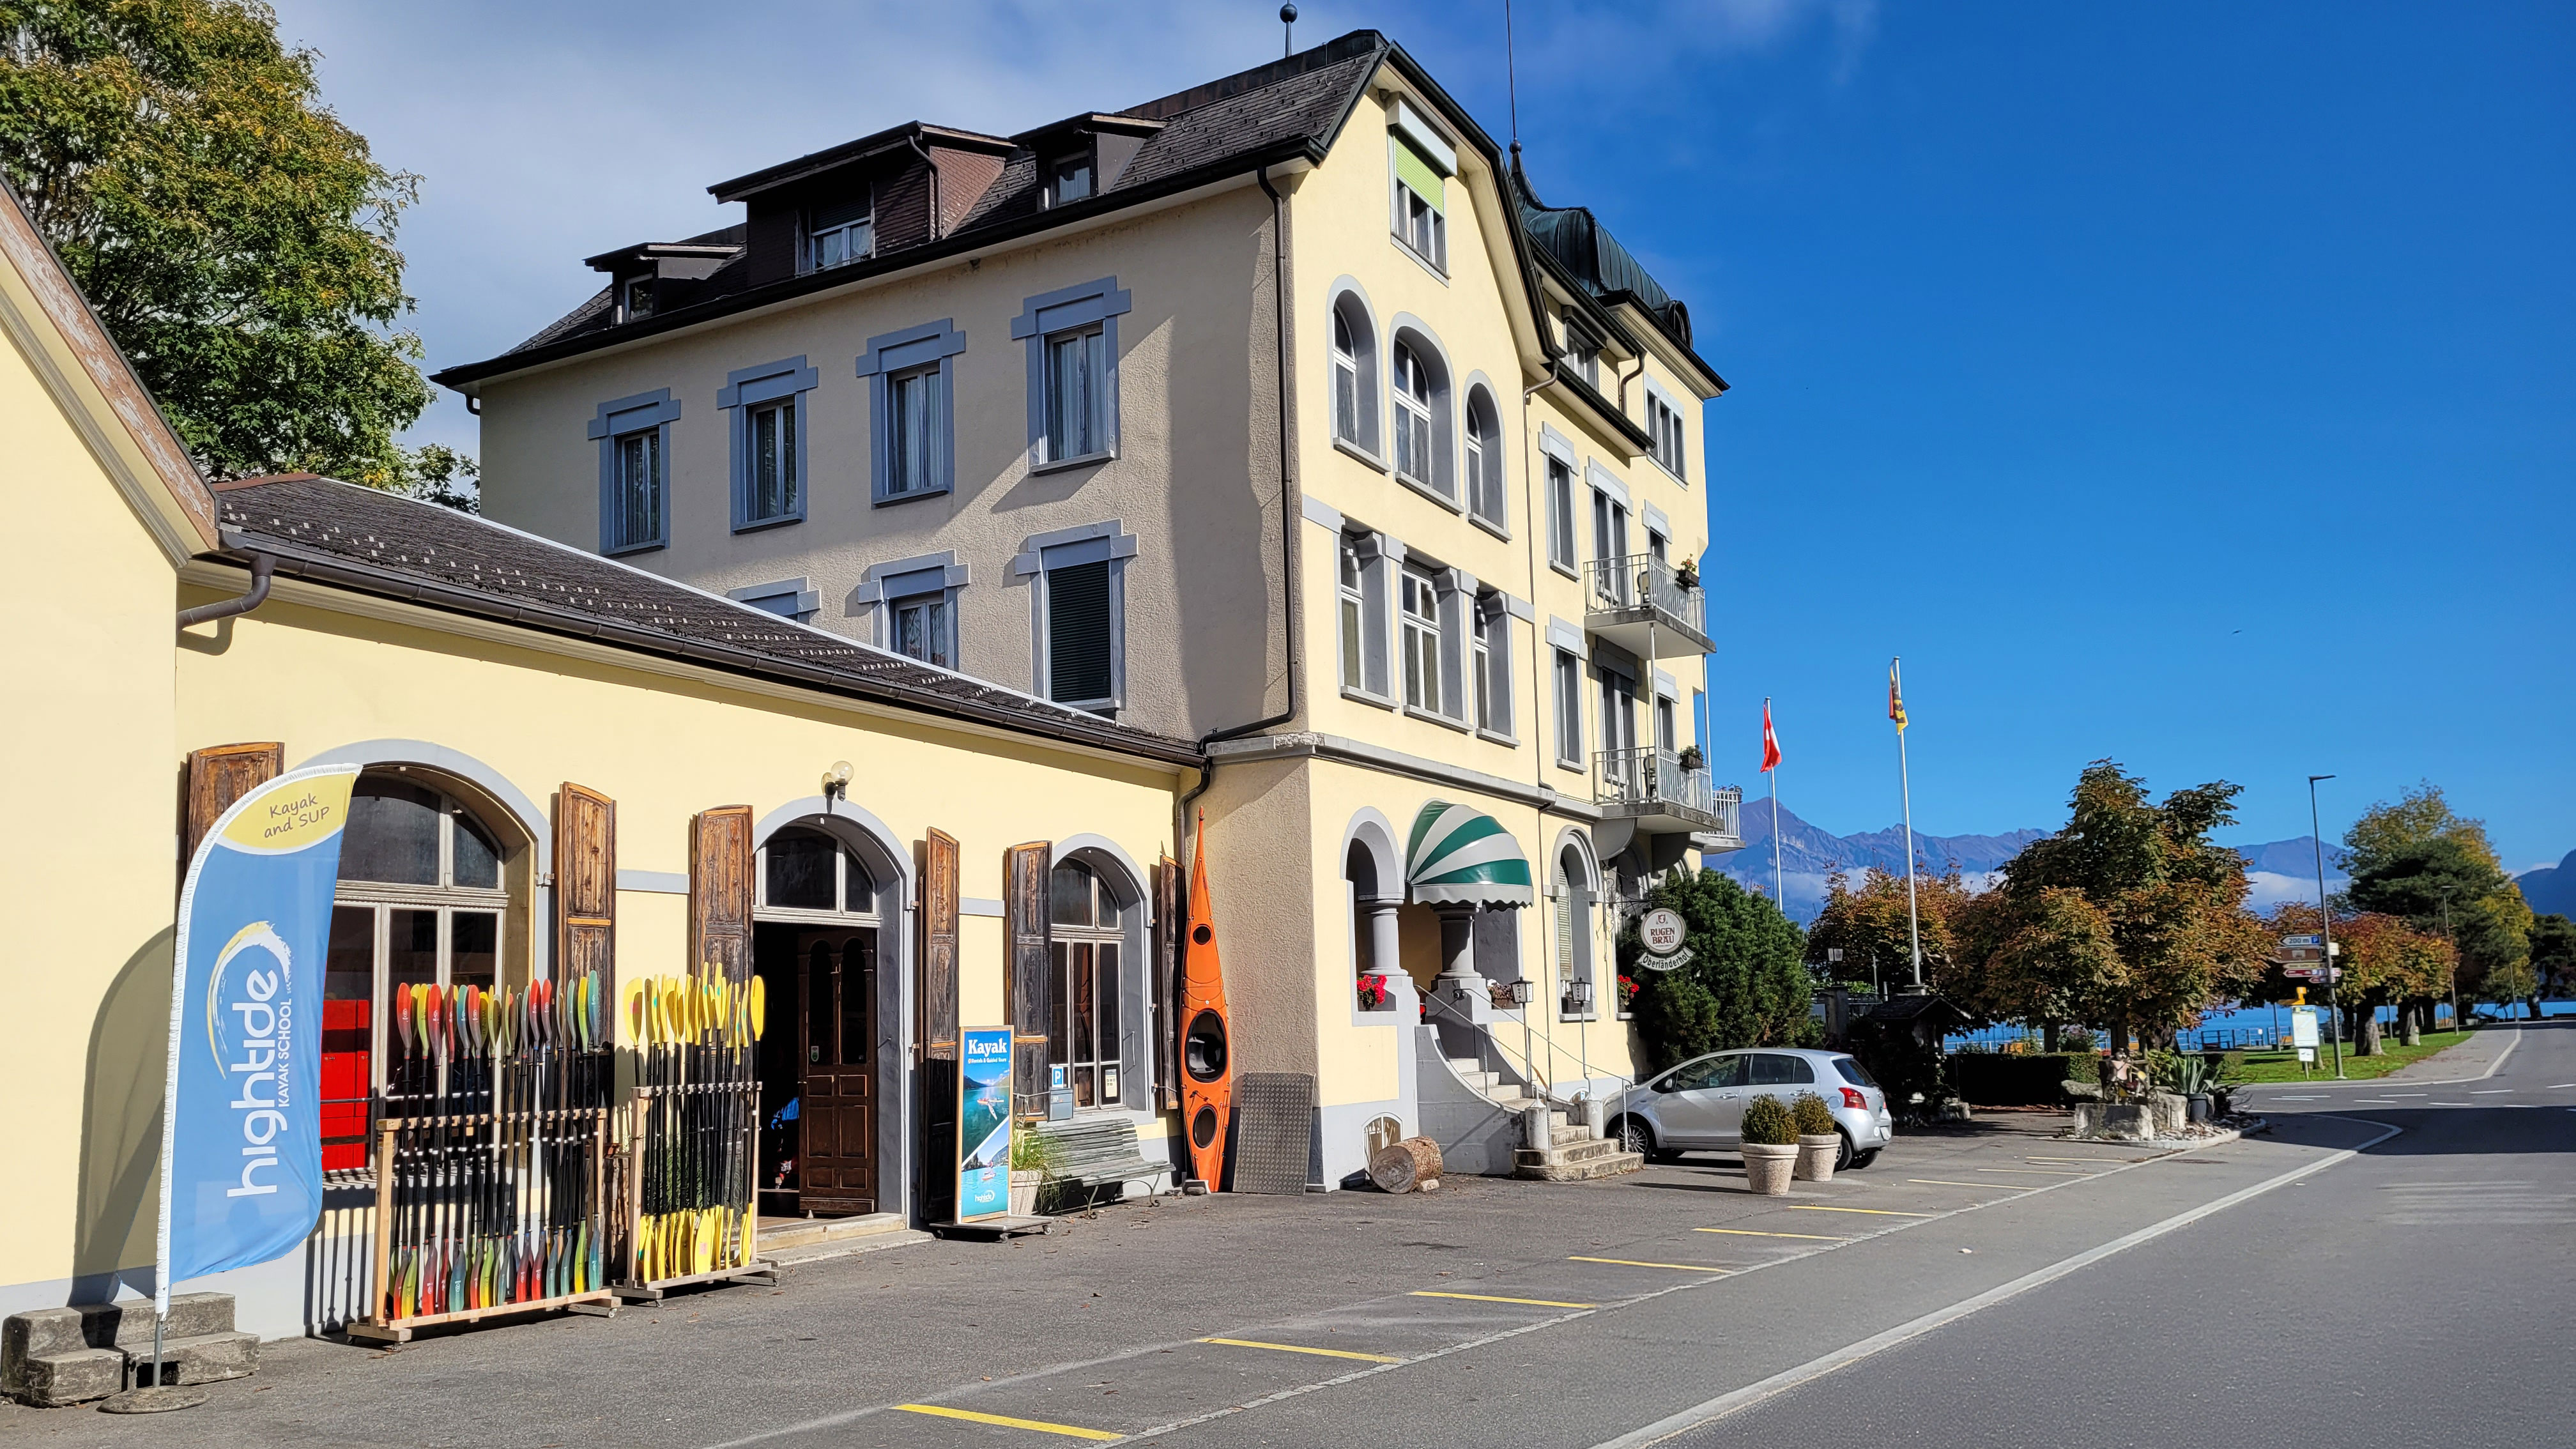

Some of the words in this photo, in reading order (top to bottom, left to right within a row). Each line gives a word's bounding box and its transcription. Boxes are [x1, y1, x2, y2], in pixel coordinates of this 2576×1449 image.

[270, 793, 318, 819] Kayak
[264, 816, 293, 838] and
[298, 806, 330, 827] SUP
[1650, 927, 1675, 937] RUGEN
[1652, 935, 1675, 944] BRÄU
[1643, 949, 1691, 969] Oberländerhof
[278, 998, 292, 1060] SCHOOL
[968, 1038, 1008, 1057] Kayak
[226, 969, 288, 1197] hightide
[278, 1064, 290, 1107] KAYAK
[1055, 1070, 1061, 1084] P
